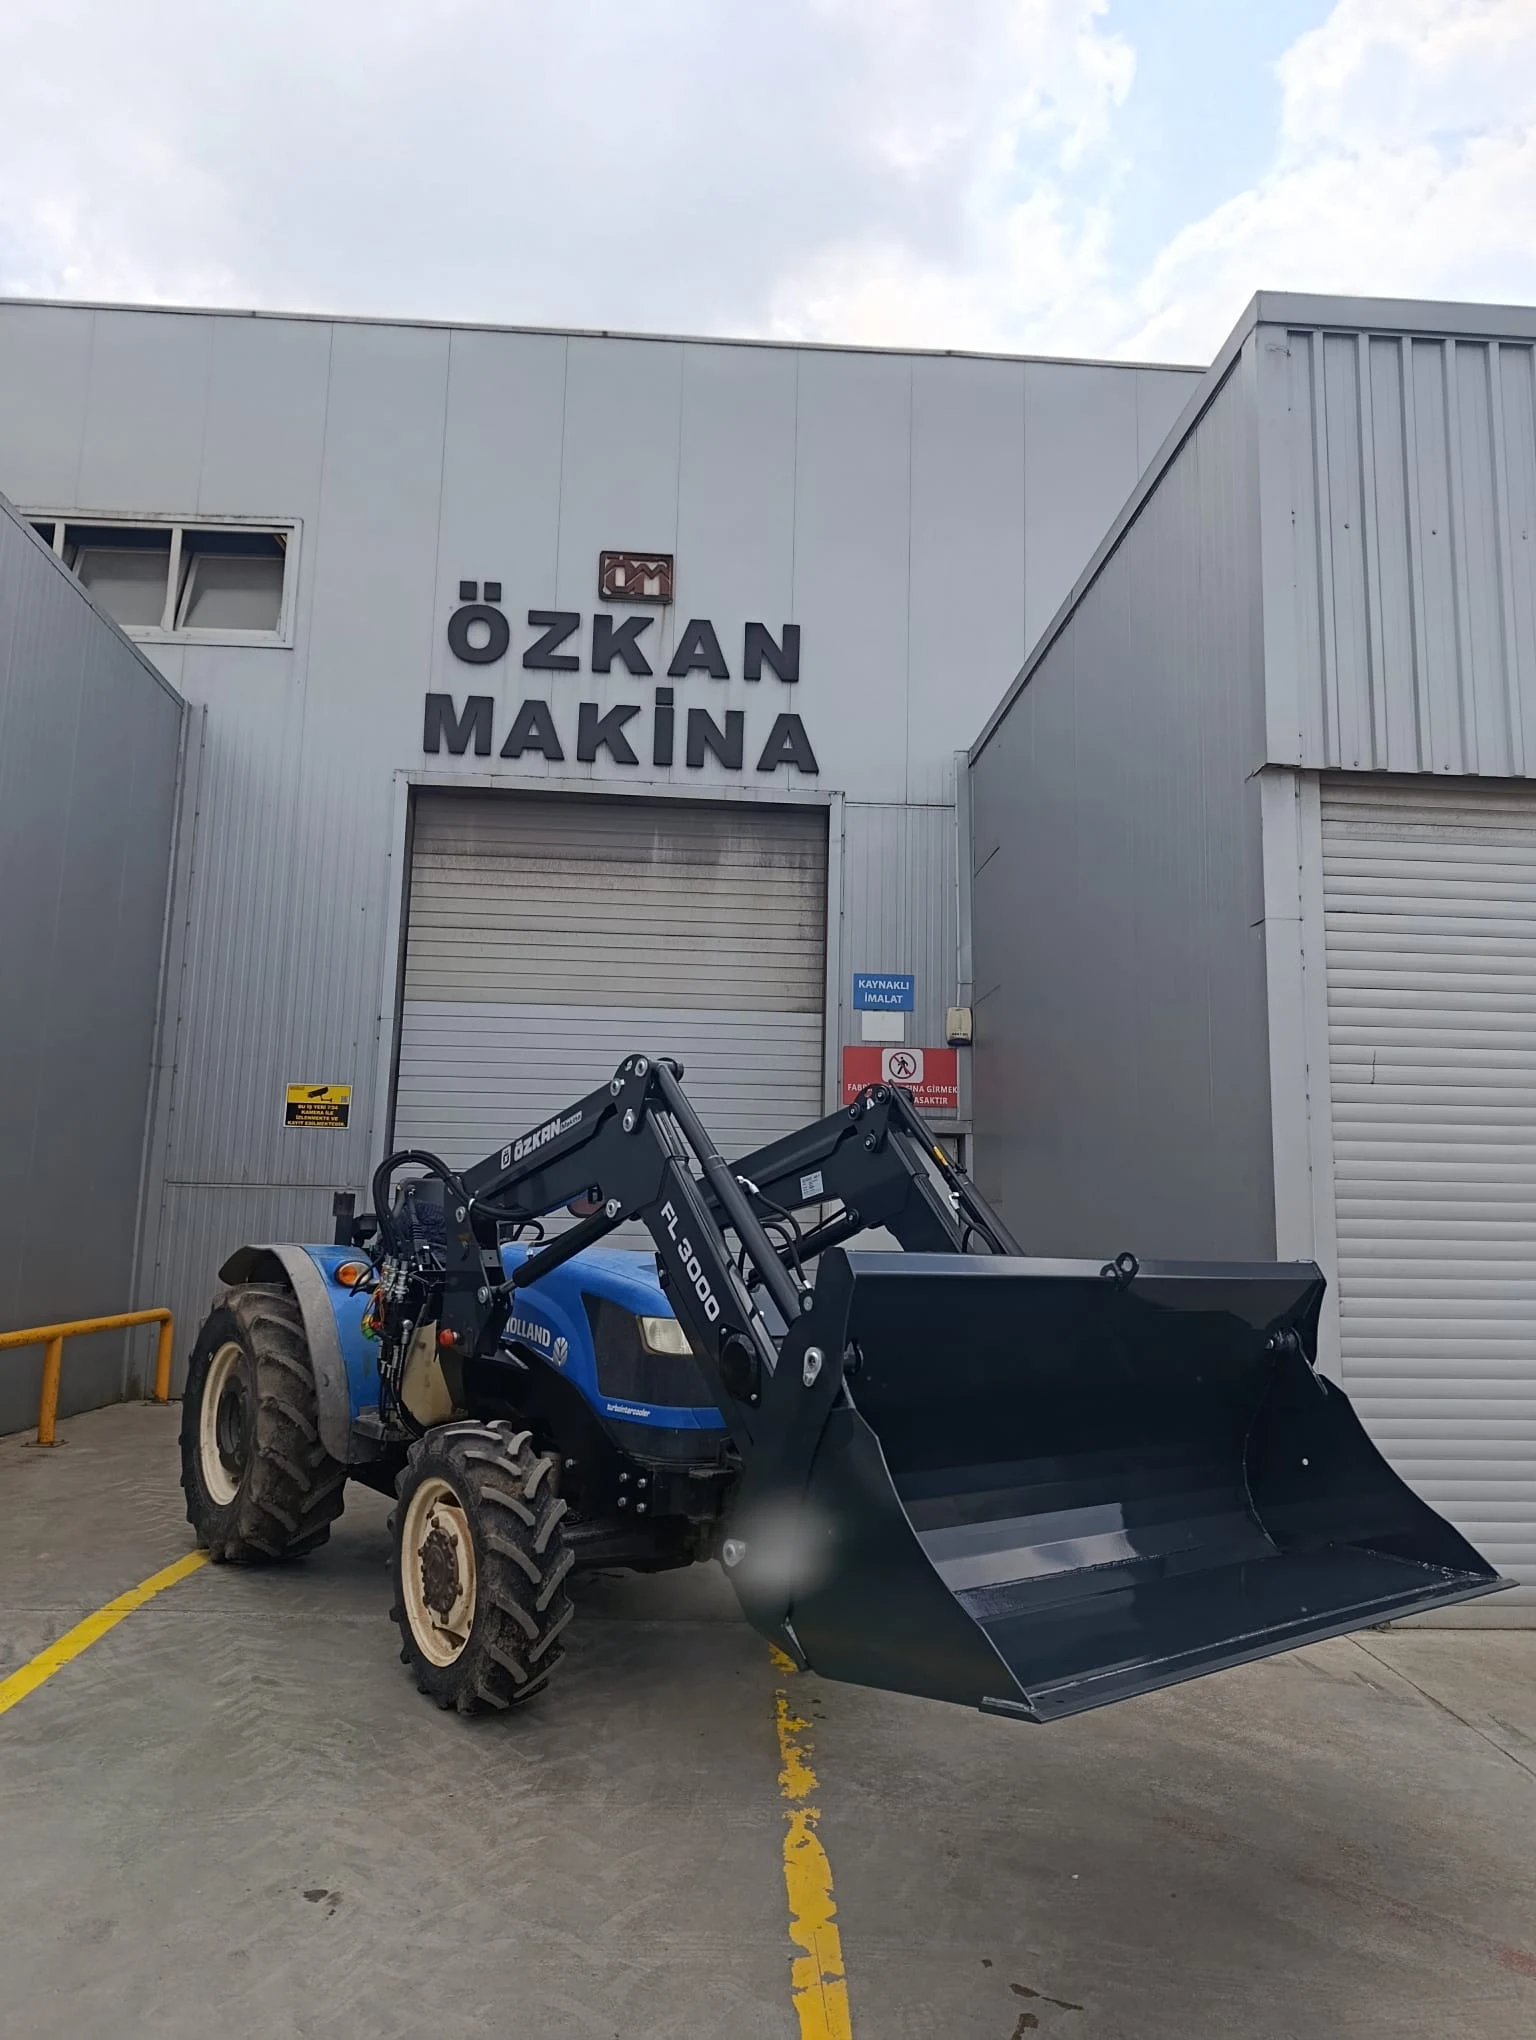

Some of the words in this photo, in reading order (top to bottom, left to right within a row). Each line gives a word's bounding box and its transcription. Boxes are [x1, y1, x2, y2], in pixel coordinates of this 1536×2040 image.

[447, 581, 801, 683] ÖZKAN
[423, 687, 820, 774] MAKİNA
[858, 979, 910, 990] KAYNAKLI
[864, 992, 903, 1004] İMALAT
[913, 1096, 948, 1105] ASAKTIR
[926, 1084, 958, 1094] GİRMEK
[513, 1117, 561, 1162] ÖZKAN
[660, 1200, 679, 1241] FL
[677, 1237, 720, 1322] 3000
